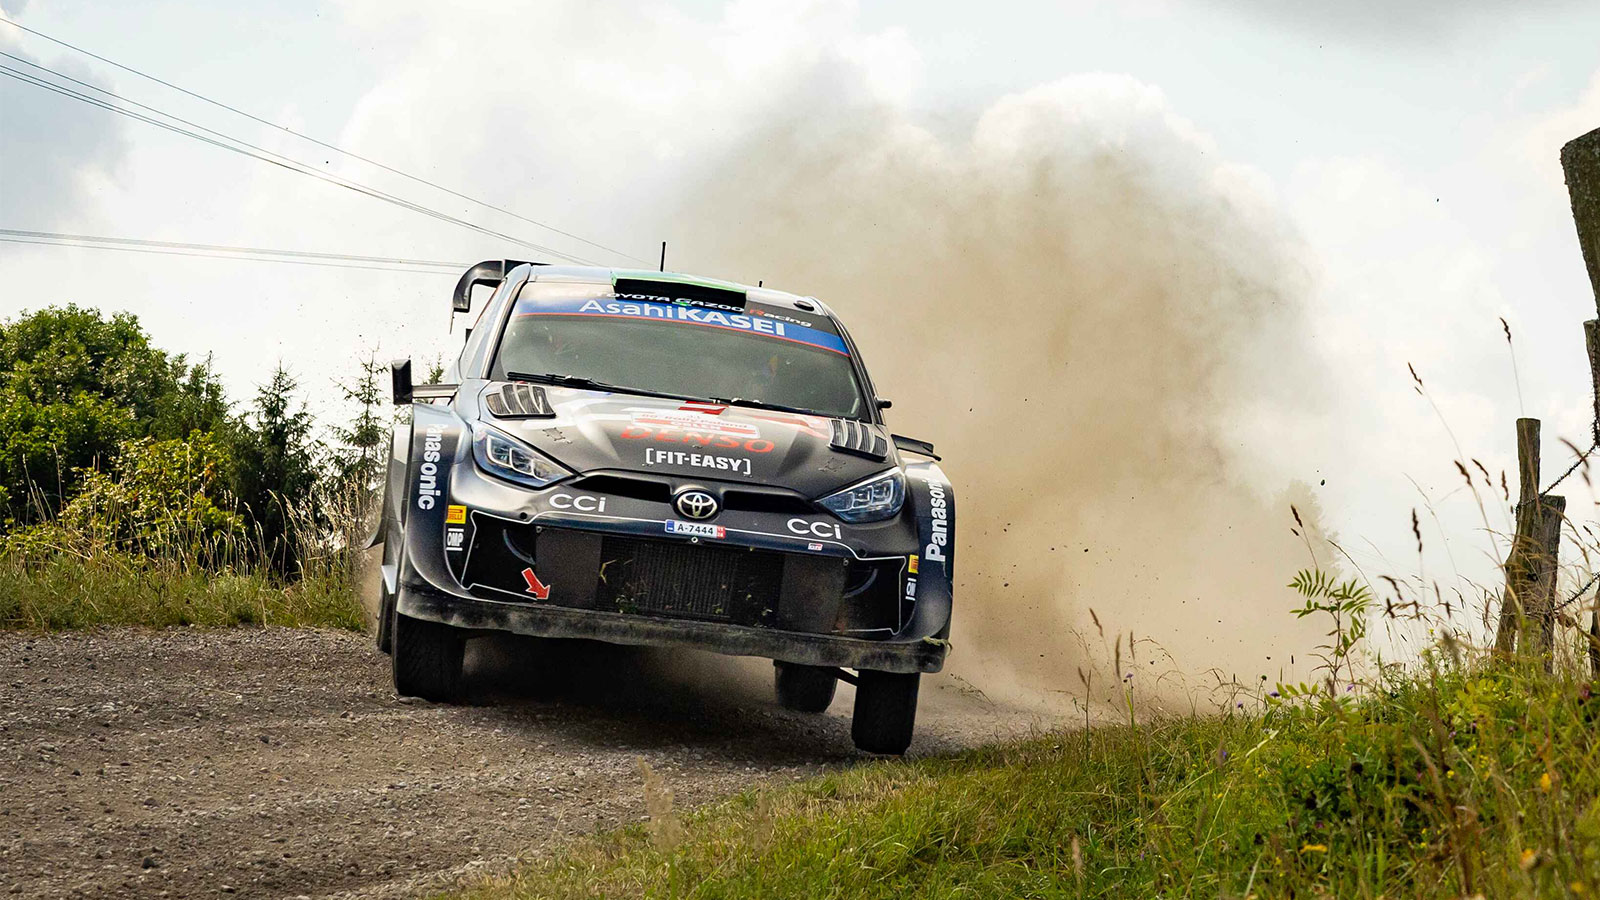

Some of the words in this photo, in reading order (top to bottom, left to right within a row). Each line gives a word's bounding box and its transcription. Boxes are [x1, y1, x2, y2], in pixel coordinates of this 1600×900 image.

[749, 309, 812, 327] Racing
[620, 425, 775, 453] DENSO
[677, 523, 714, 535] A-7444
